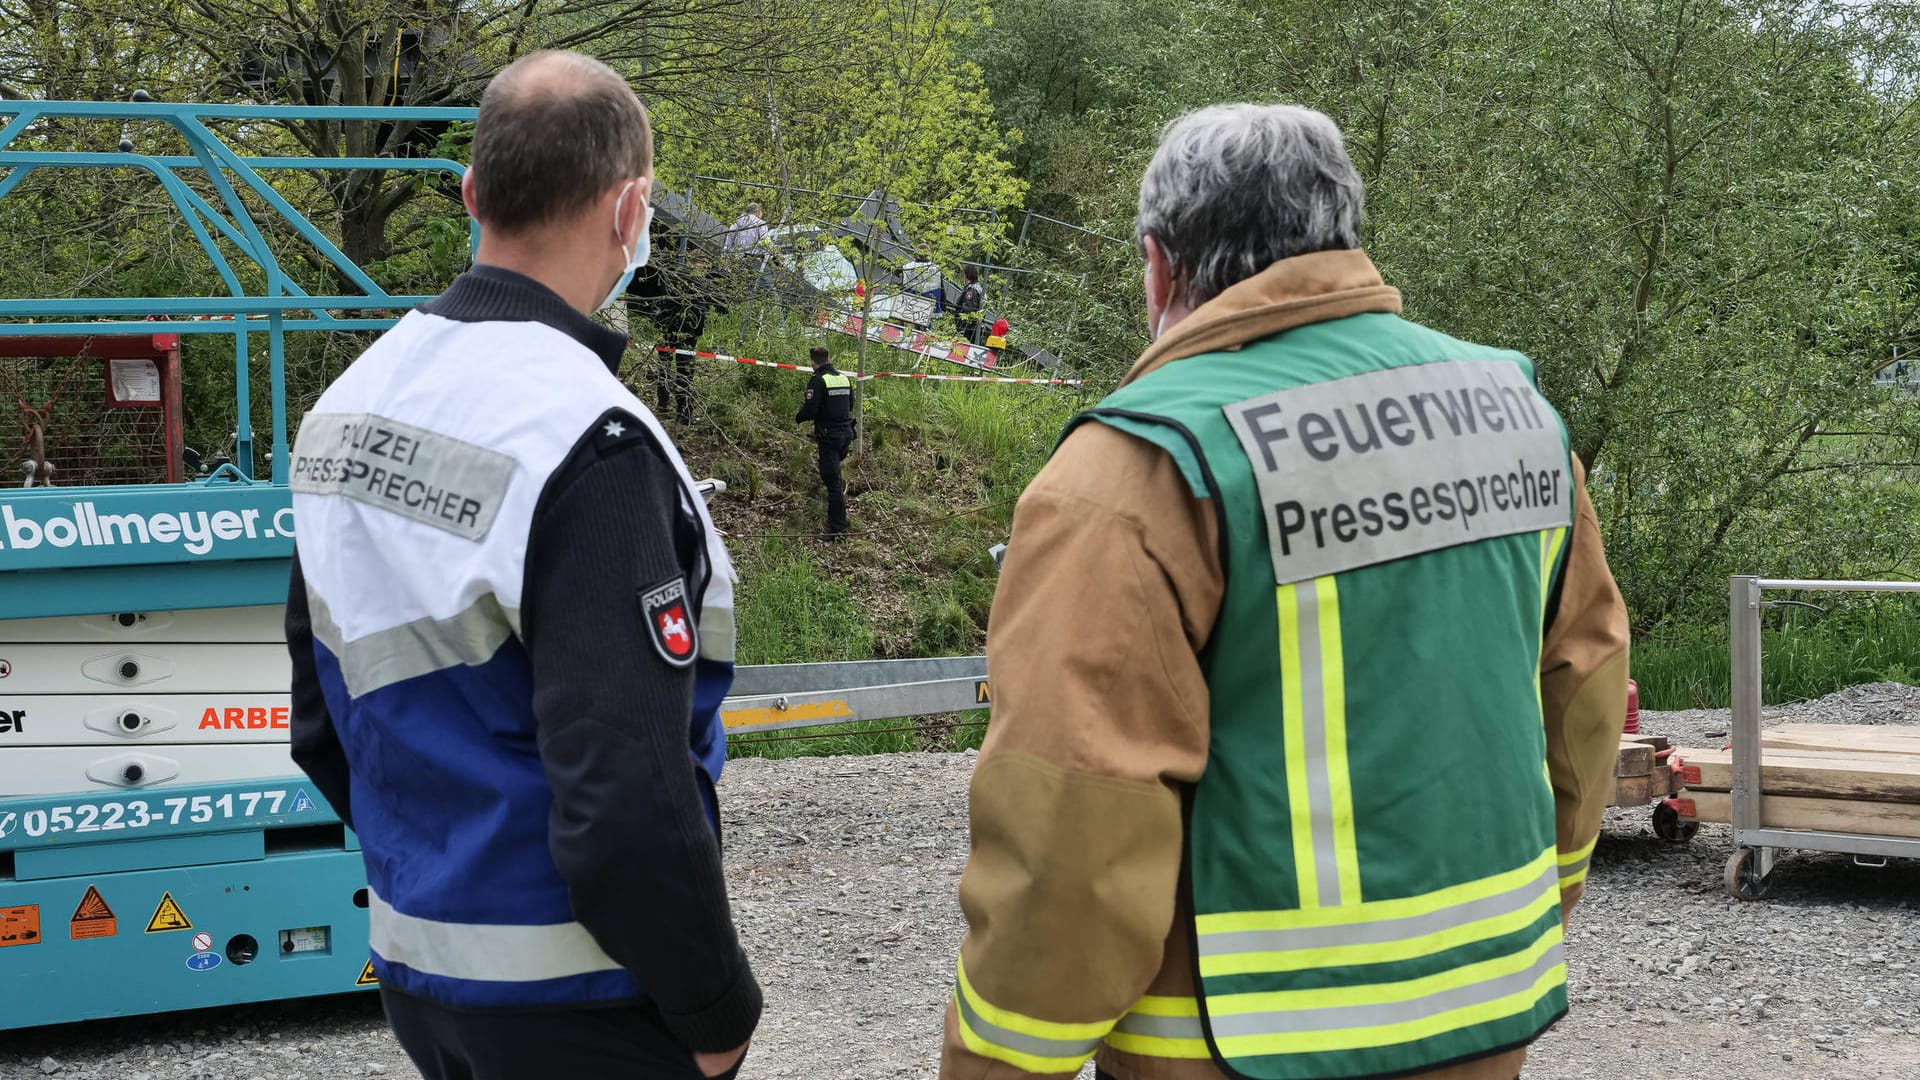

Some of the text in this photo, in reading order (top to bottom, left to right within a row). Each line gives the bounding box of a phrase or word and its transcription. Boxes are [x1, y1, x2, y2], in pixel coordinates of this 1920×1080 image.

[341, 424, 420, 466] PLIZEI
[1241, 372, 1544, 472] Feuerwehr
[294, 456, 482, 528] PRESSPRECHER
[1274, 458, 1560, 556] Pressesprecher
[198, 707, 289, 730] ARBE
[23, 790, 287, 838] 05223-75177
